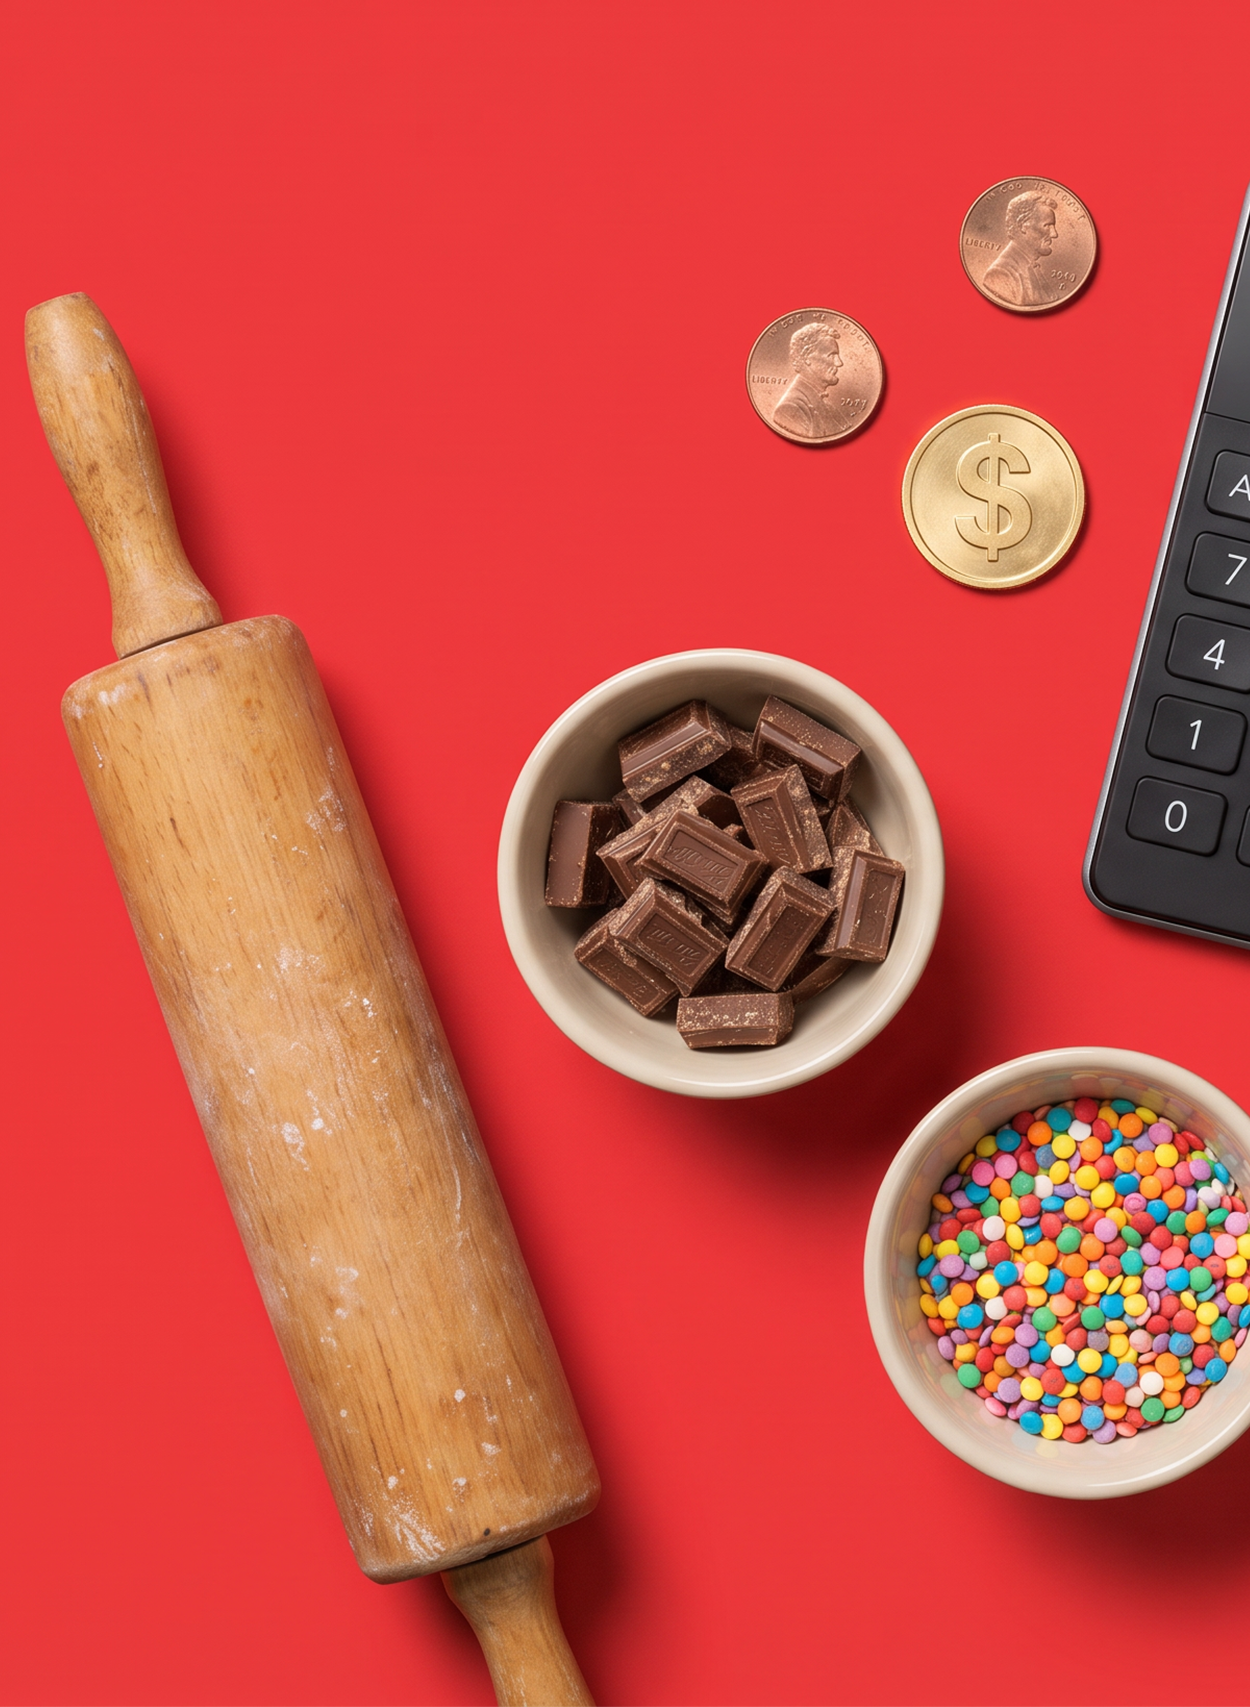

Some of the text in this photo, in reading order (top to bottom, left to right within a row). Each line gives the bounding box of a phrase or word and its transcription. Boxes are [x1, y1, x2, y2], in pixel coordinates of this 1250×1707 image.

[954, 432, 1032, 562] $
[1224, 553, 1248, 586] 7
[1202, 638, 1226, 671] 4
[1188, 719, 1203, 751] 1
[1164, 800, 1188, 833] 0
